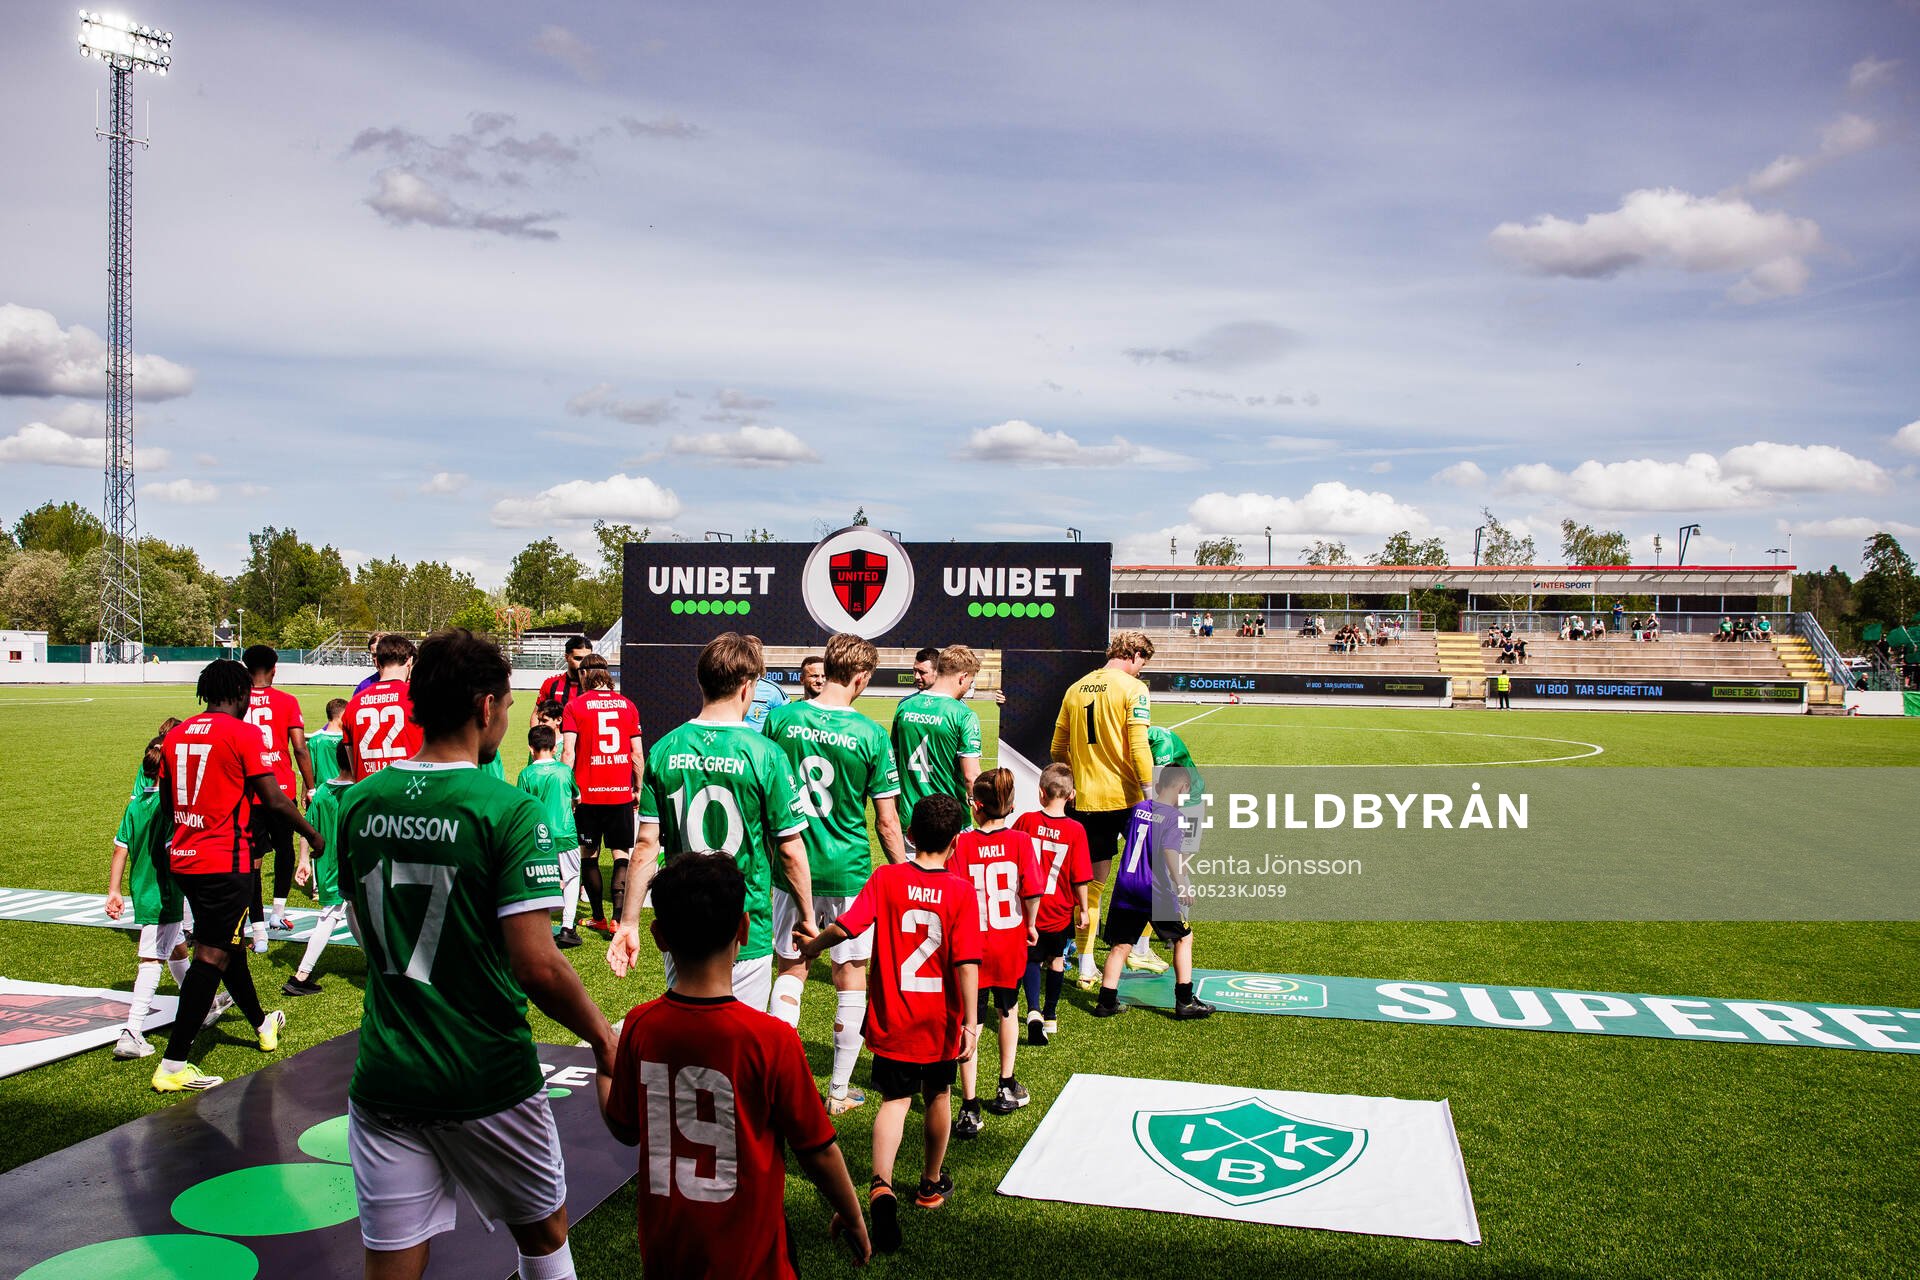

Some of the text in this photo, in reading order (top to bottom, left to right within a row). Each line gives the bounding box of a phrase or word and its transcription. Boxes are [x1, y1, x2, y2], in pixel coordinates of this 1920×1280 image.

[648, 566, 775, 595] UNIBET
[837, 571, 879, 582] UNITED
[943, 567, 1082, 597] UNIBET
[1190, 678, 1255, 690] SÖDERTÄLJE
[1535, 683, 1546, 695] VI
[1575, 684, 1594, 696] TAR
[1596, 684, 1663, 697] SUPERETTAN
[360, 692, 399, 706] SÖDERBERG
[586, 699, 628, 711] ANDERSSON
[356, 705, 408, 760] 22
[597, 711, 621, 754] 5
[903, 711, 943, 726] PERSSON
[1083, 699, 1098, 744] 1
[786, 724, 858, 750] SPORRONG
[613, 753, 629, 765] WOK
[668, 753, 745, 776] BERGGREN
[907, 734, 935, 783] 4
[175, 743, 213, 806] 17
[797, 754, 835, 818] 8
[360, 814, 460, 843] JONSSON
[666, 782, 744, 857] 10
[1037, 824, 1061, 840] BITAR
[978, 844, 1005, 858] VARLI
[1126, 823, 1149, 873] 1
[525, 864, 560, 878] UNIBE
[907, 884, 943, 905] VARLI
[968, 861, 1024, 932] 18
[359, 857, 459, 986] 17
[900, 908, 943, 993] 2
[1215, 991, 1309, 1002] SUPERETTAN
[1376, 982, 1920, 1051] SUPERE
[640, 1060, 738, 1203] 19
[1179, 1123, 1336, 1158] I K
[1217, 1157, 1266, 1184] B
